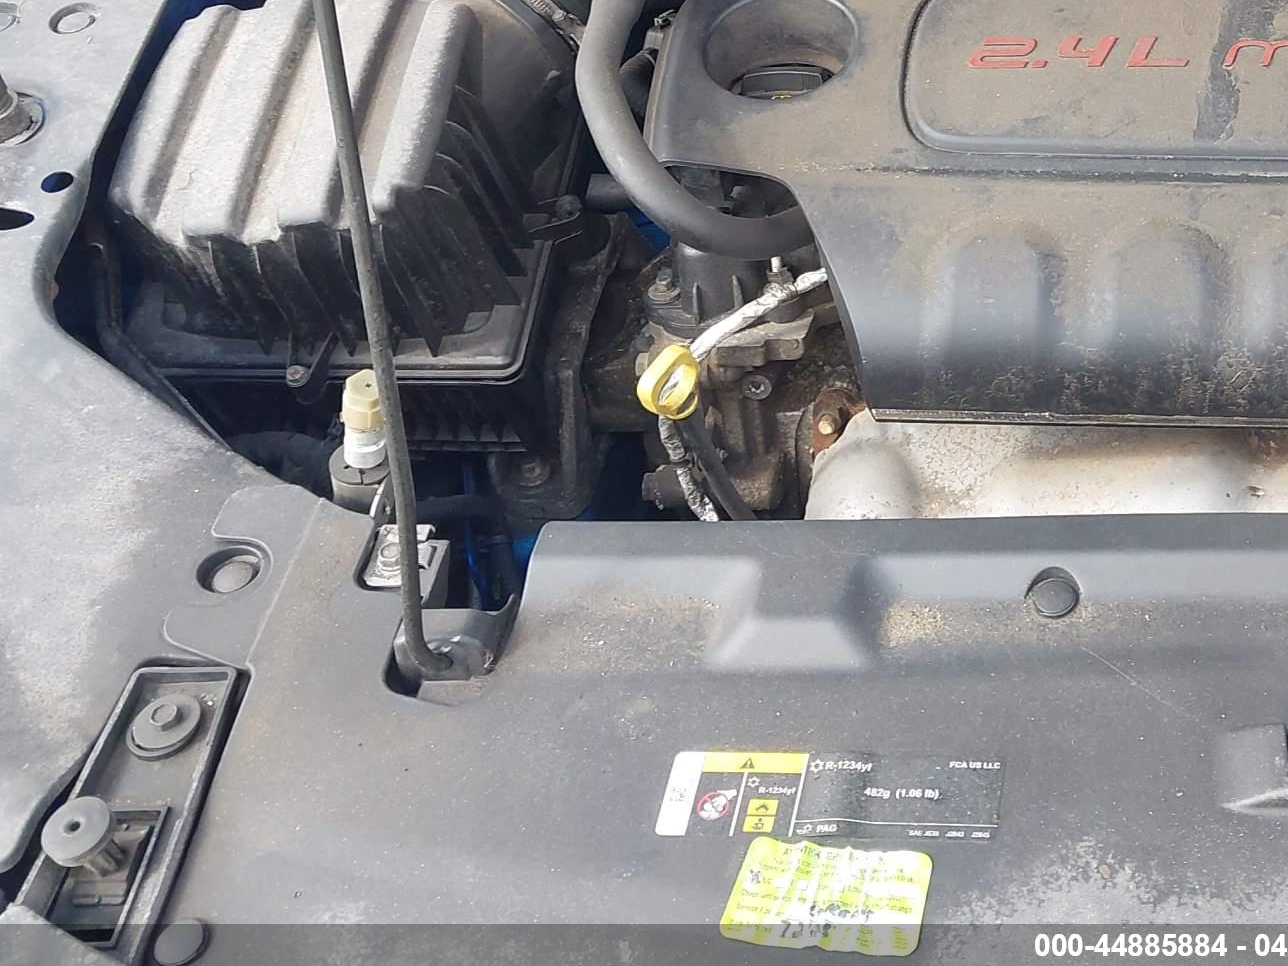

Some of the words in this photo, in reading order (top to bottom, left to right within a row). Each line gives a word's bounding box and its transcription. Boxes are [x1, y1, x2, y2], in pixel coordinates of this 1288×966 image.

[824, 760, 873, 772] R-1234yf
[949, 761, 968, 769] FCA
[969, 761, 982, 769] US
[758, 785, 797, 796] R-1234yf
[863, 787, 891, 799] 482g
[895, 788, 923, 800] (1.06
[924, 788, 941, 800] lb)
[816, 824, 838, 833] PAG
